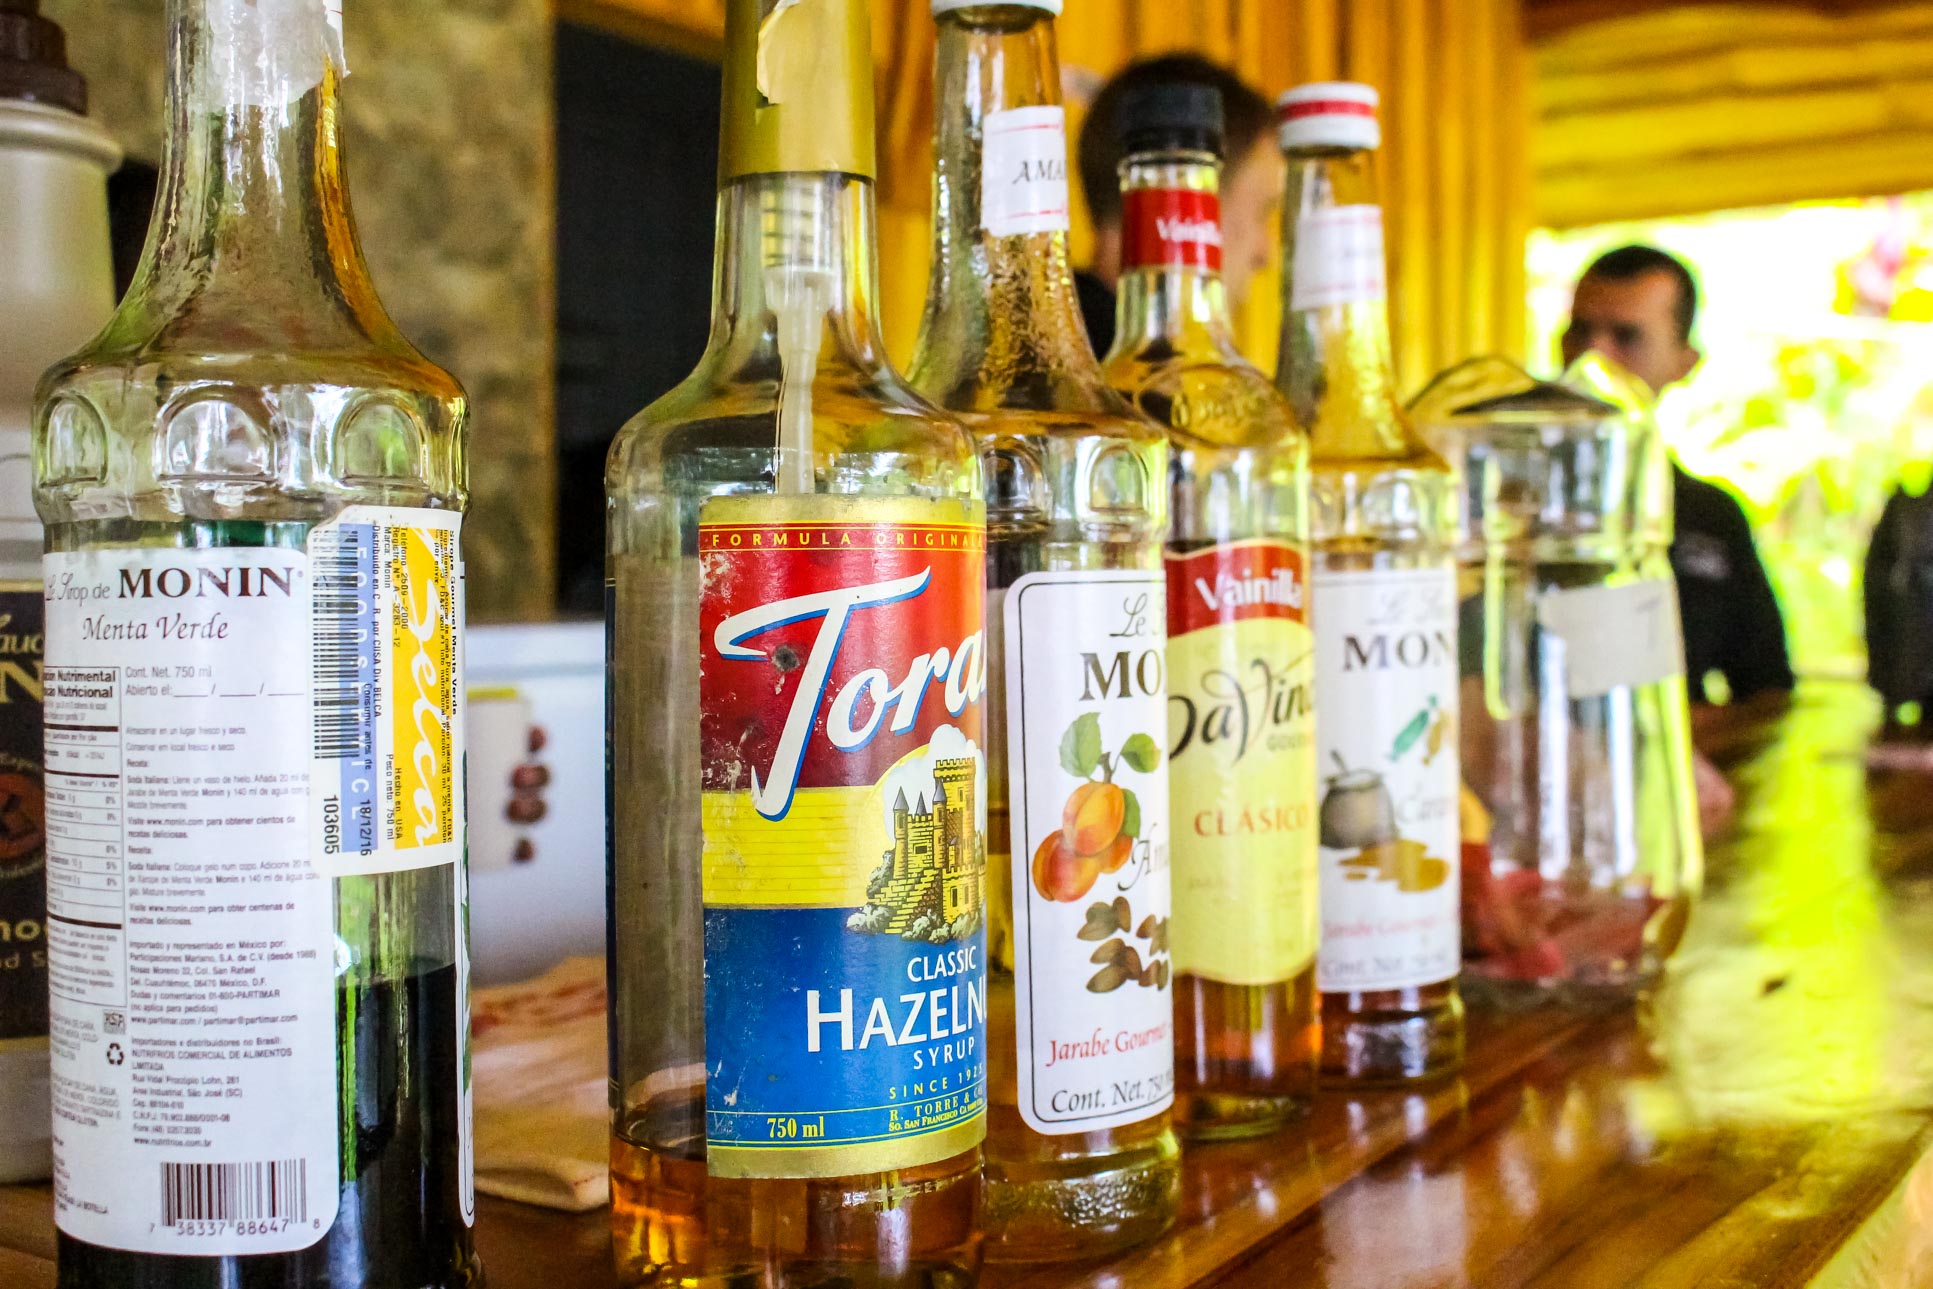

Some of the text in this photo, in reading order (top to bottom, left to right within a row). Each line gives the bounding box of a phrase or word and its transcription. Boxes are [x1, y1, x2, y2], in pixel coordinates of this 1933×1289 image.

[372, 525, 381, 575] Distribuido
[392, 527, 400, 563] Registro
[712, 532, 851, 547] FORMULA
[92, 584, 110, 599] de
[118, 567, 295, 599] MONIN
[372, 578, 380, 589] en
[384, 561, 392, 588] Monin
[82, 612, 229, 640] Menta Verde
[1109, 592, 1148, 637] Le
[372, 621, 380, 636] por
[57, 670, 116, 683] Nutrimental
[125, 667, 147, 678] Cont.
[151, 667, 171, 678] Net.
[175, 667, 195, 678] 750
[57, 683, 113, 698] Nutricional
[125, 684, 157, 696] Abierto
[374, 687, 382, 717] BELCA
[364, 683, 372, 727] Consumir
[365, 759, 372, 770] de
[386, 754, 394, 777] Peso
[323, 795, 340, 855] 103605
[360, 799, 372, 856] 18/12/16
[386, 808, 394, 824] 750
[386, 829, 394, 840] ml
[395, 819, 403, 839] USA
[907, 946, 977, 982] CLASSIC
[913, 1036, 975, 1070] SYRUP
[1045, 1027, 1110, 1067] Jarabe
[889, 1077, 948, 1099] SINCE
[1051, 1089, 1106, 1113] Cont.
[1112, 1080, 1145, 1105] Net.
[890, 1109, 904, 1120] R.
[914, 1096, 959, 1117] TORRE
[964, 1092, 969, 1103] &
[767, 1116, 825, 1139] 750 ml
[150, 1218, 321, 1236] 7 38337 88647 8
